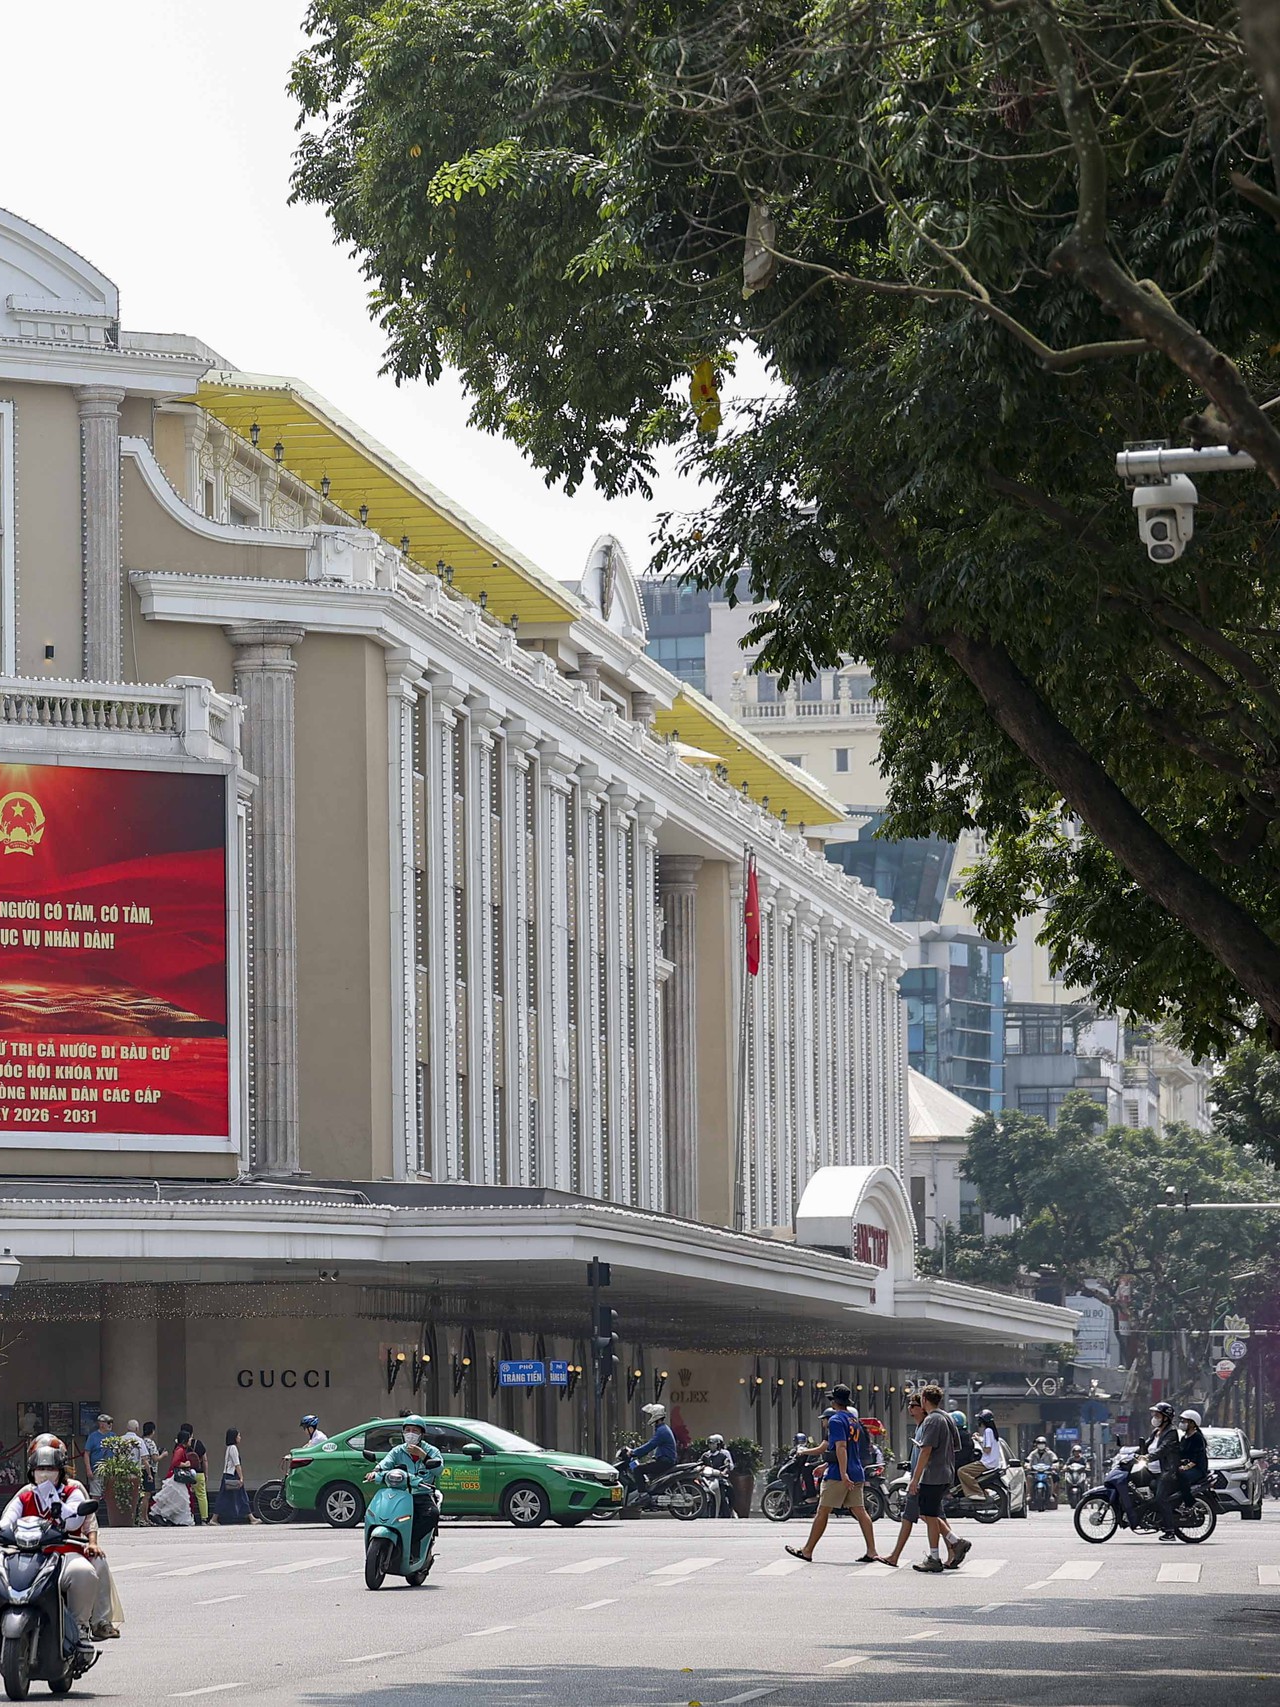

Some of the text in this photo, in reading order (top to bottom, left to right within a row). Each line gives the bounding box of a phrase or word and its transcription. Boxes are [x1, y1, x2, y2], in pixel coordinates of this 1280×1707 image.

[0, 899, 40, 919] NGƯỜI
[43, 901, 63, 920] CÓ
[65, 901, 97, 923] TÂM,
[100, 903, 119, 923] CÓ
[122, 901, 154, 925] TẦM,
[22, 929, 40, 949] VỤ
[44, 928, 80, 948] NHÂN
[83, 929, 115, 949] DÂN!
[10, 1042, 33, 1057] TRI
[37, 1039, 56, 1057] CẢ
[60, 1042, 97, 1058] NƯỚC
[101, 1045, 116, 1059] ĐI
[120, 1042, 148, 1060] BẦU
[151, 1044, 172, 1061] CỬ
[27, 1062, 51, 1081] HỘI
[55, 1064, 92, 1080] KHÓA
[96, 1066, 119, 1081] XVI
[30, 1085, 67, 1101] NHÂN
[71, 1086, 98, 1102] DÂN
[102, 1087, 130, 1103] CÁC
[134, 1085, 162, 1104] CẤP
[14, 1107, 50, 1122] 2026
[63, 1109, 97, 1123] 2031
[237, 1369, 330, 1388] GUCCI
[503, 1371, 526, 1383] TRÀNG
[670, 1390, 709, 1403] OLEX
[460, 1481, 481, 1491] 1055
